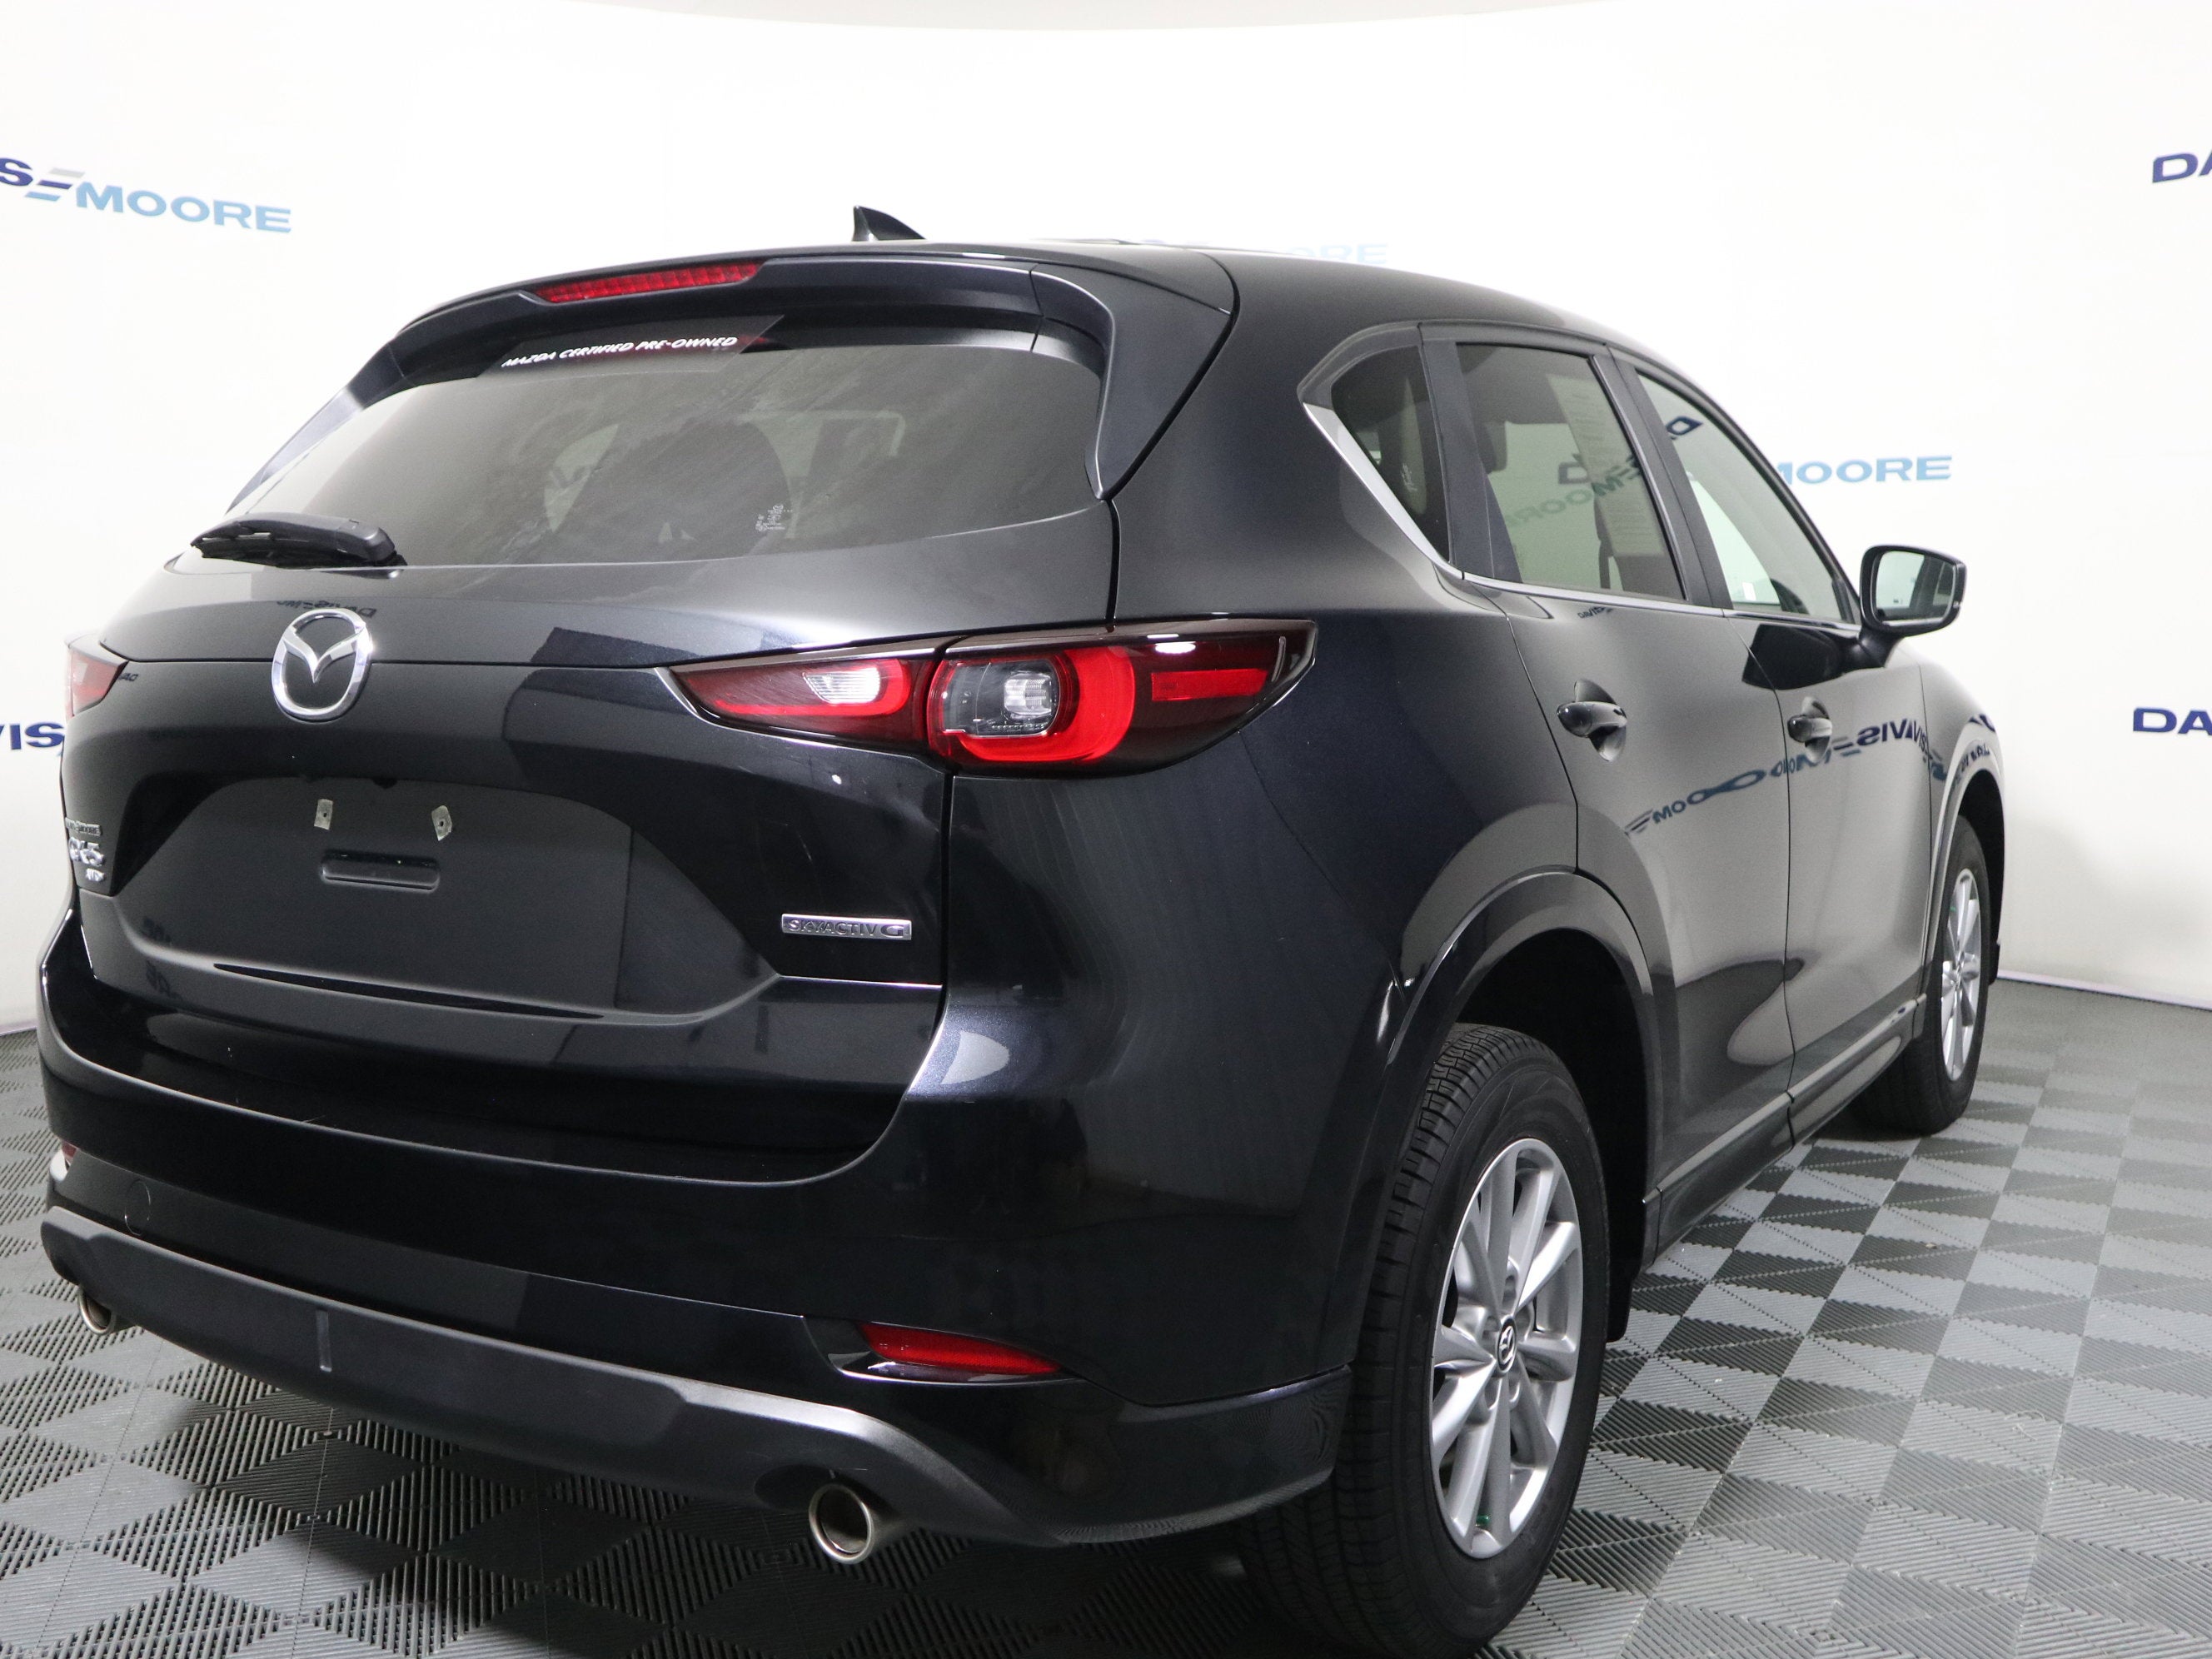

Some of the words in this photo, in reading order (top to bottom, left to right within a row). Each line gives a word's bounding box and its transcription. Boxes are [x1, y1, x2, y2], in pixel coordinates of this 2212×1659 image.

[76, 181, 291, 233] MOORE
[501, 351, 557, 367] MAZDA
[559, 341, 635, 359] CERTIFIED
[634, 336, 739, 352] PRE-OWNED
[788, 919, 878, 937] SKYACTIV
[880, 924, 905, 939] G
